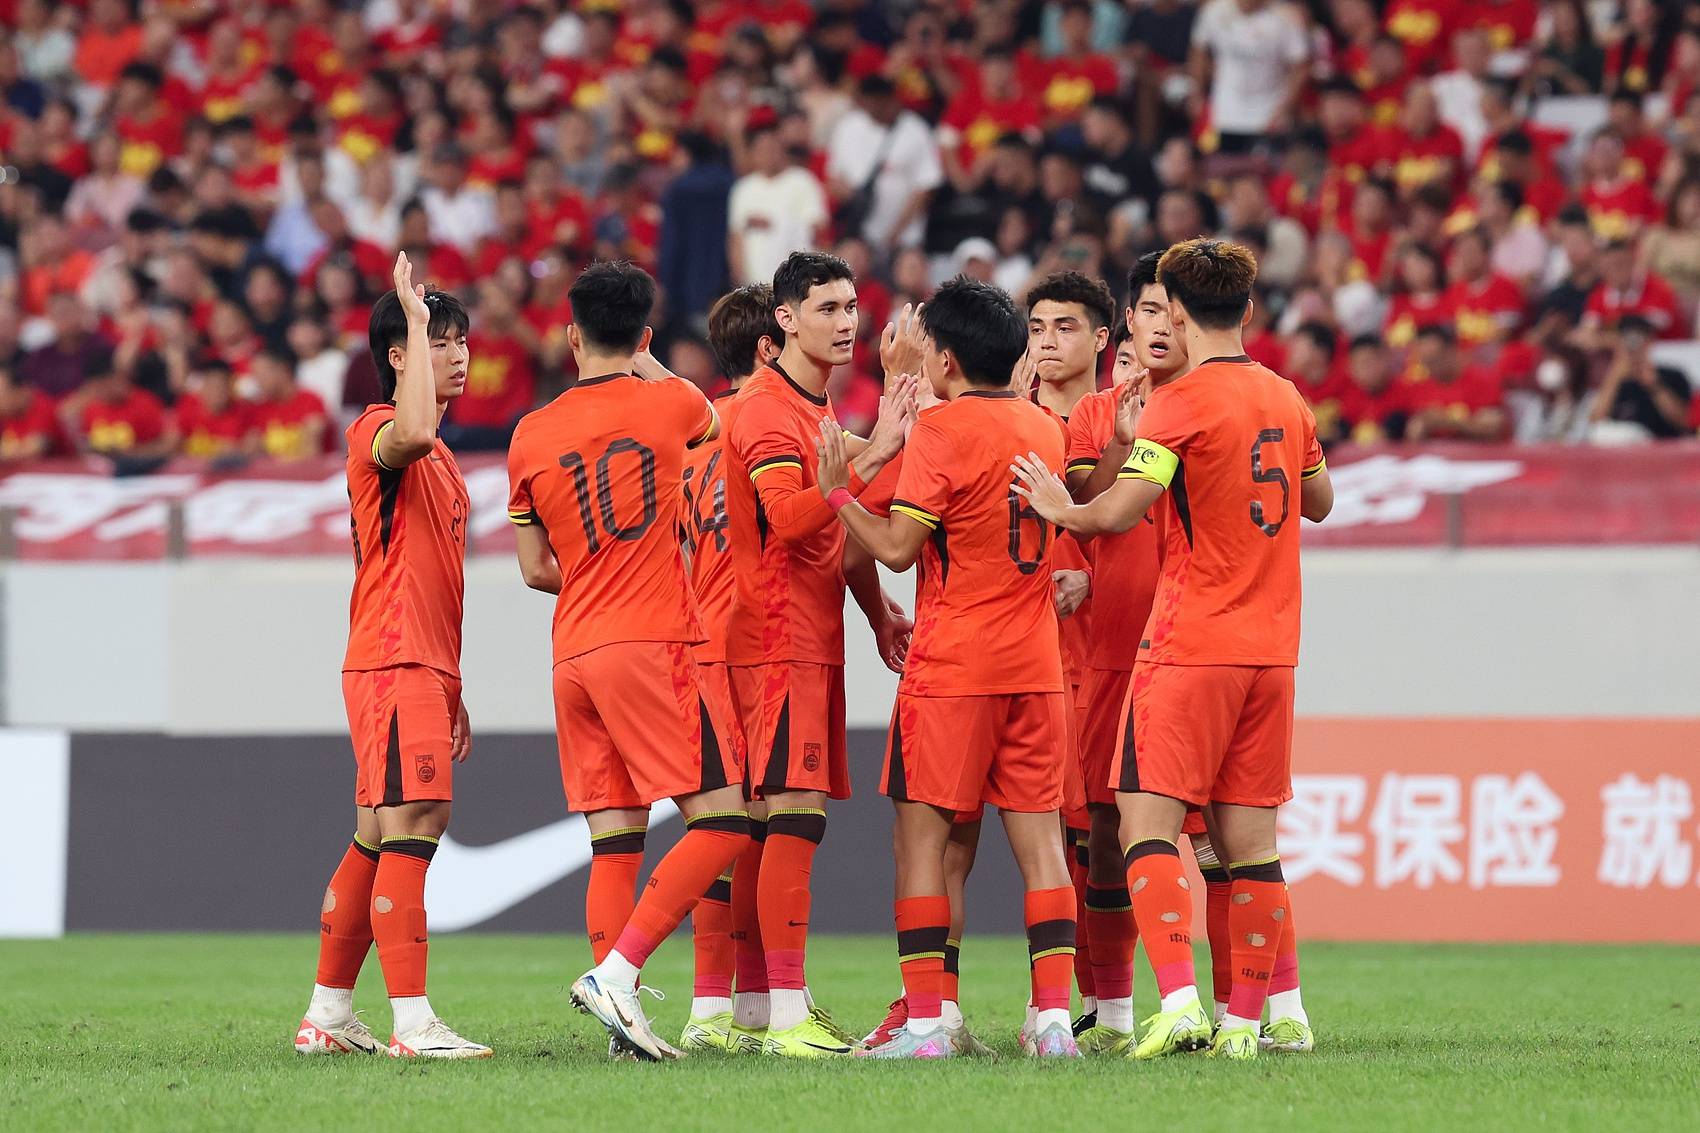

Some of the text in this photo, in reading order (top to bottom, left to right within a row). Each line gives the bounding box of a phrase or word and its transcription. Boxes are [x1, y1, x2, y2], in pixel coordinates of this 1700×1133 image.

[451, 498, 468, 547] 21
[559, 437, 657, 555] 10
[682, 450, 729, 555] 14
[1249, 428, 1290, 538] 5
[1275, 771, 1700, 890] 买保险 就
